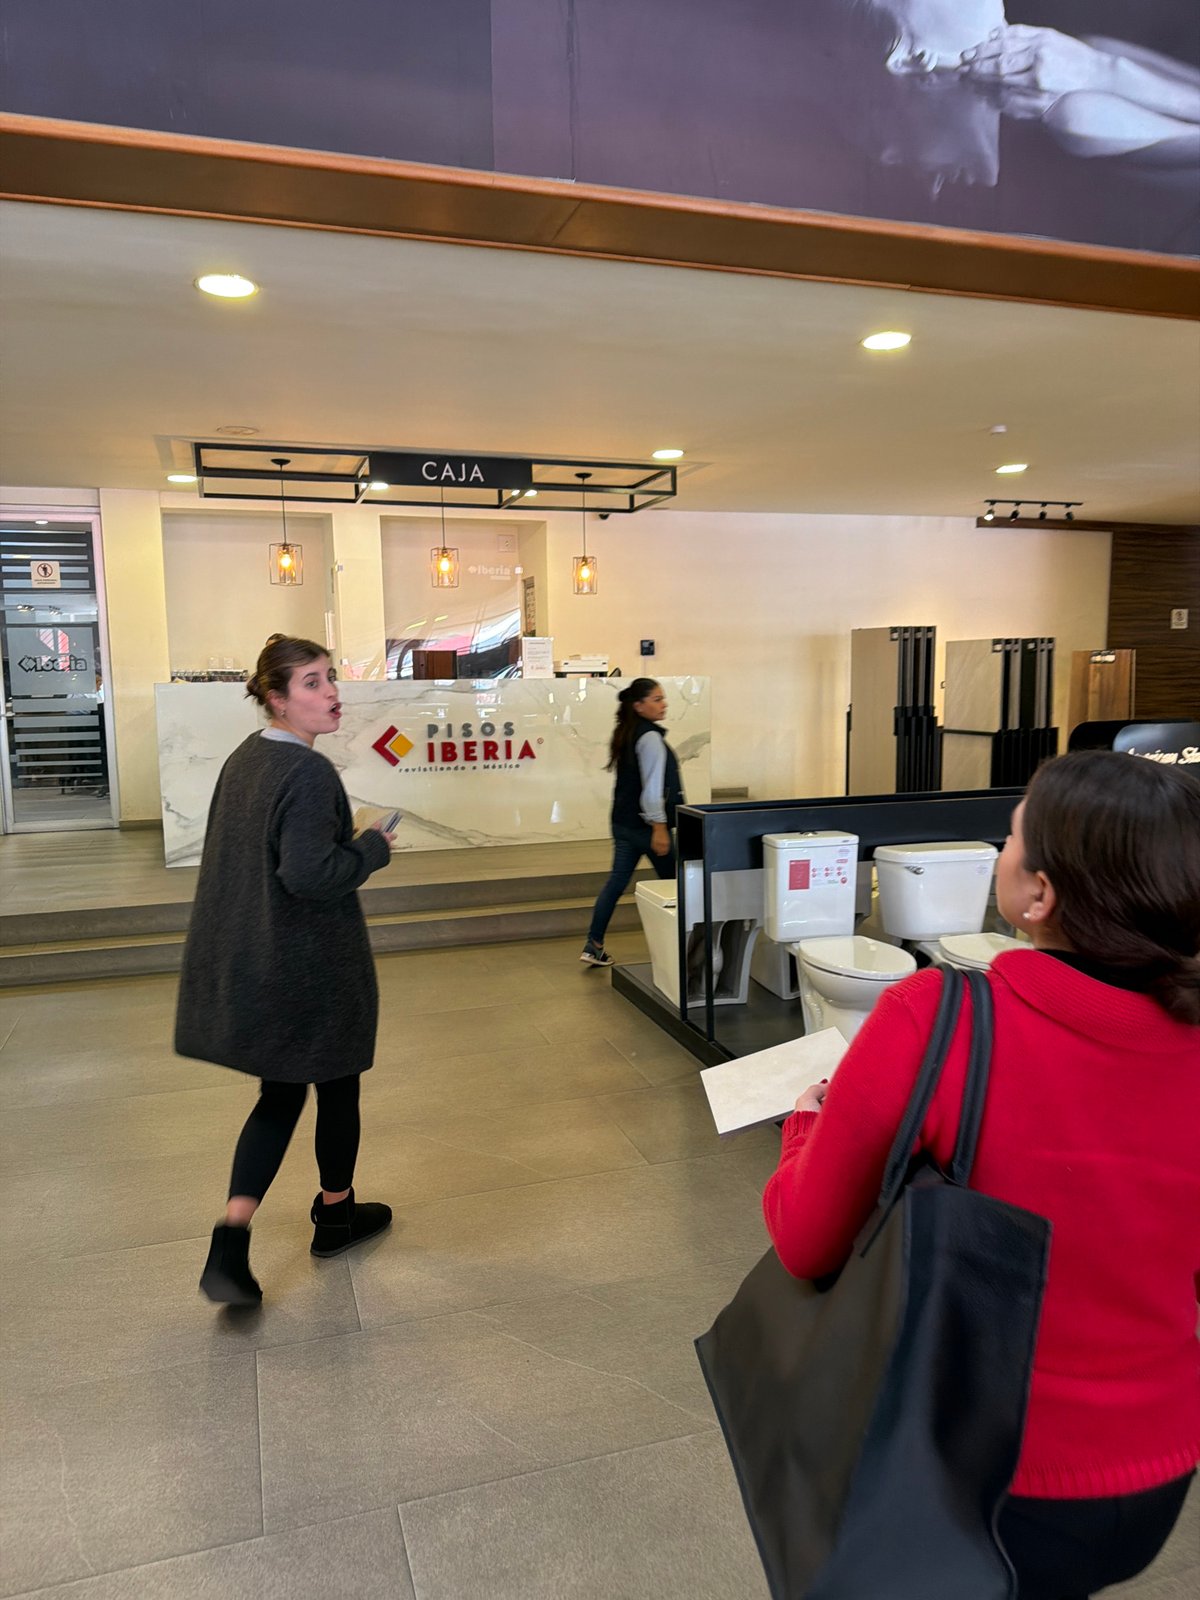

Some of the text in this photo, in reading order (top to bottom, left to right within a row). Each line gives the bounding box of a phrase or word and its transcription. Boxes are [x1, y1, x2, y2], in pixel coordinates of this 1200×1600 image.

[421, 461, 484, 482] CAJA
[427, 722, 515, 738] PISOS
[427, 739, 537, 763] IBERIA
